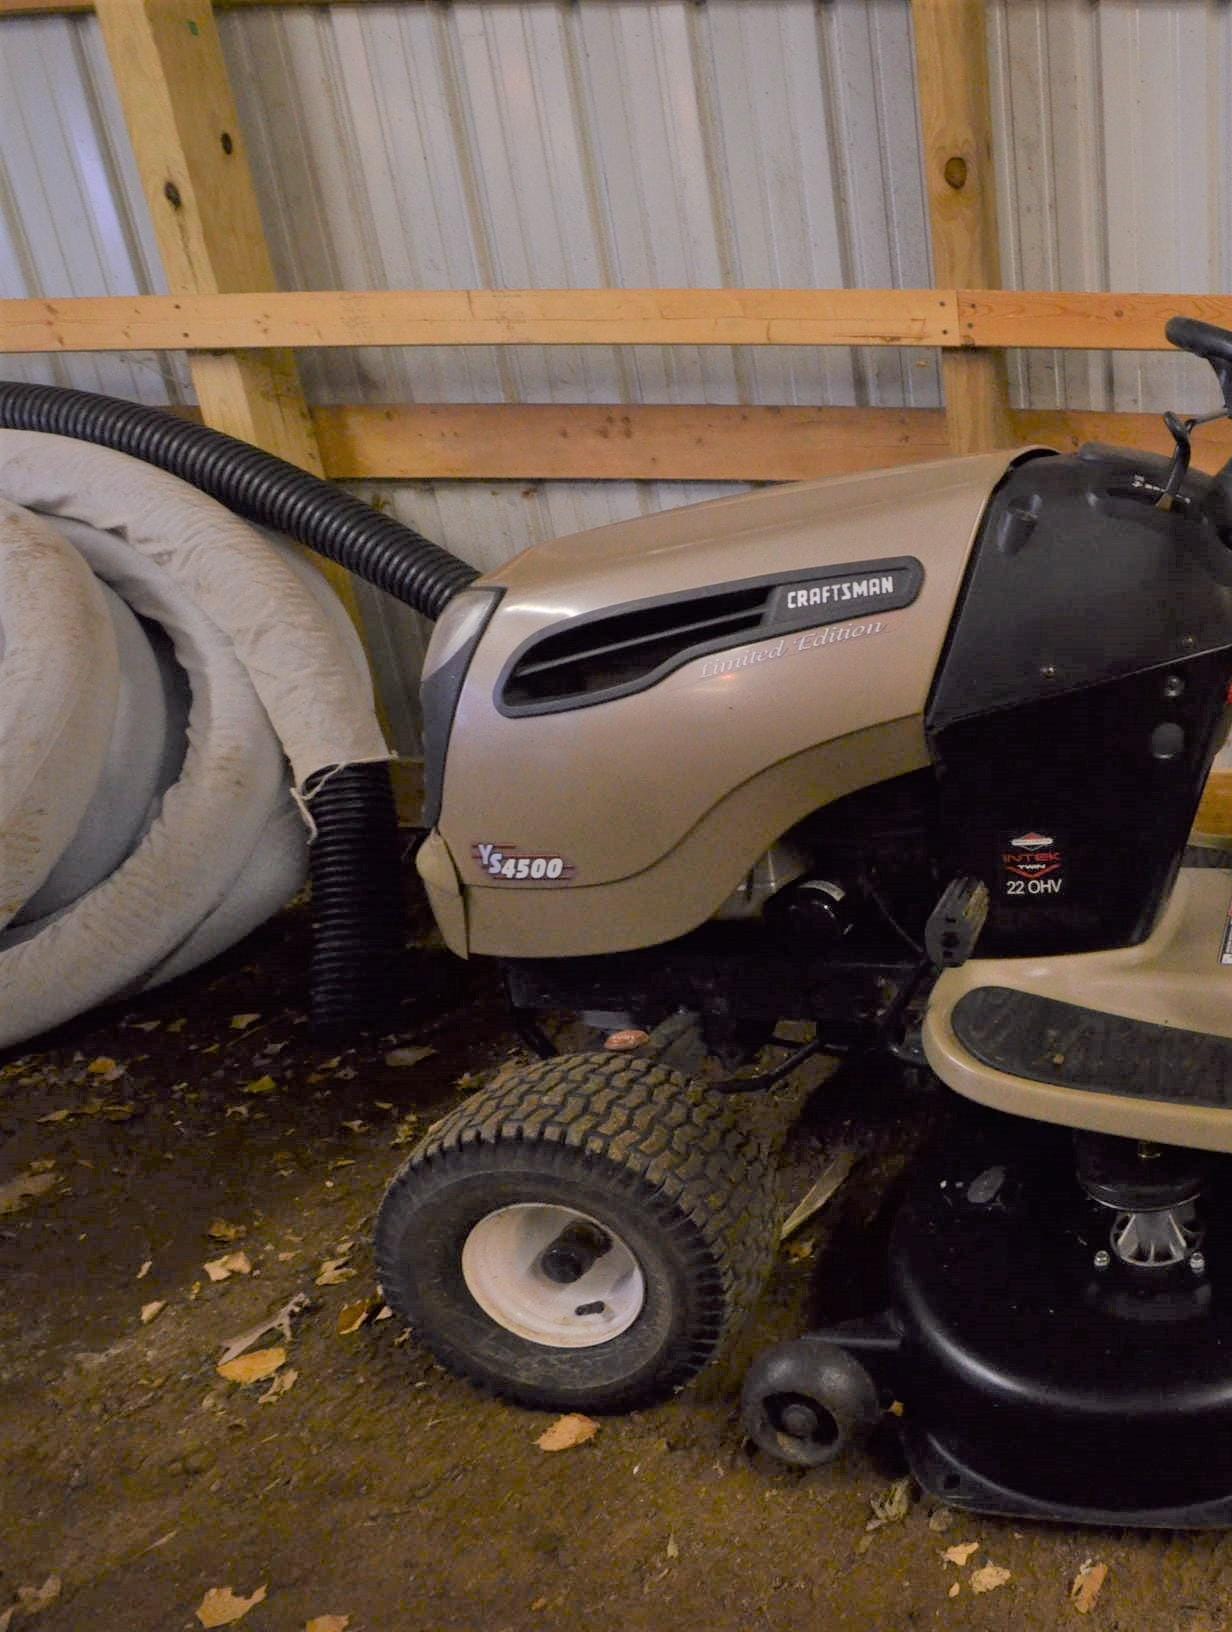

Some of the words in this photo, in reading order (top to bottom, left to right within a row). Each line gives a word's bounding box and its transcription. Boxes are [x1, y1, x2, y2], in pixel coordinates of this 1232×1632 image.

[786, 575, 894, 609] CRAFTSMAN
[700, 640, 787, 679] Limited
[794, 621, 885, 652] Edition
[1007, 881, 1025, 895] 22
[1028, 879, 1062, 894] OHV
